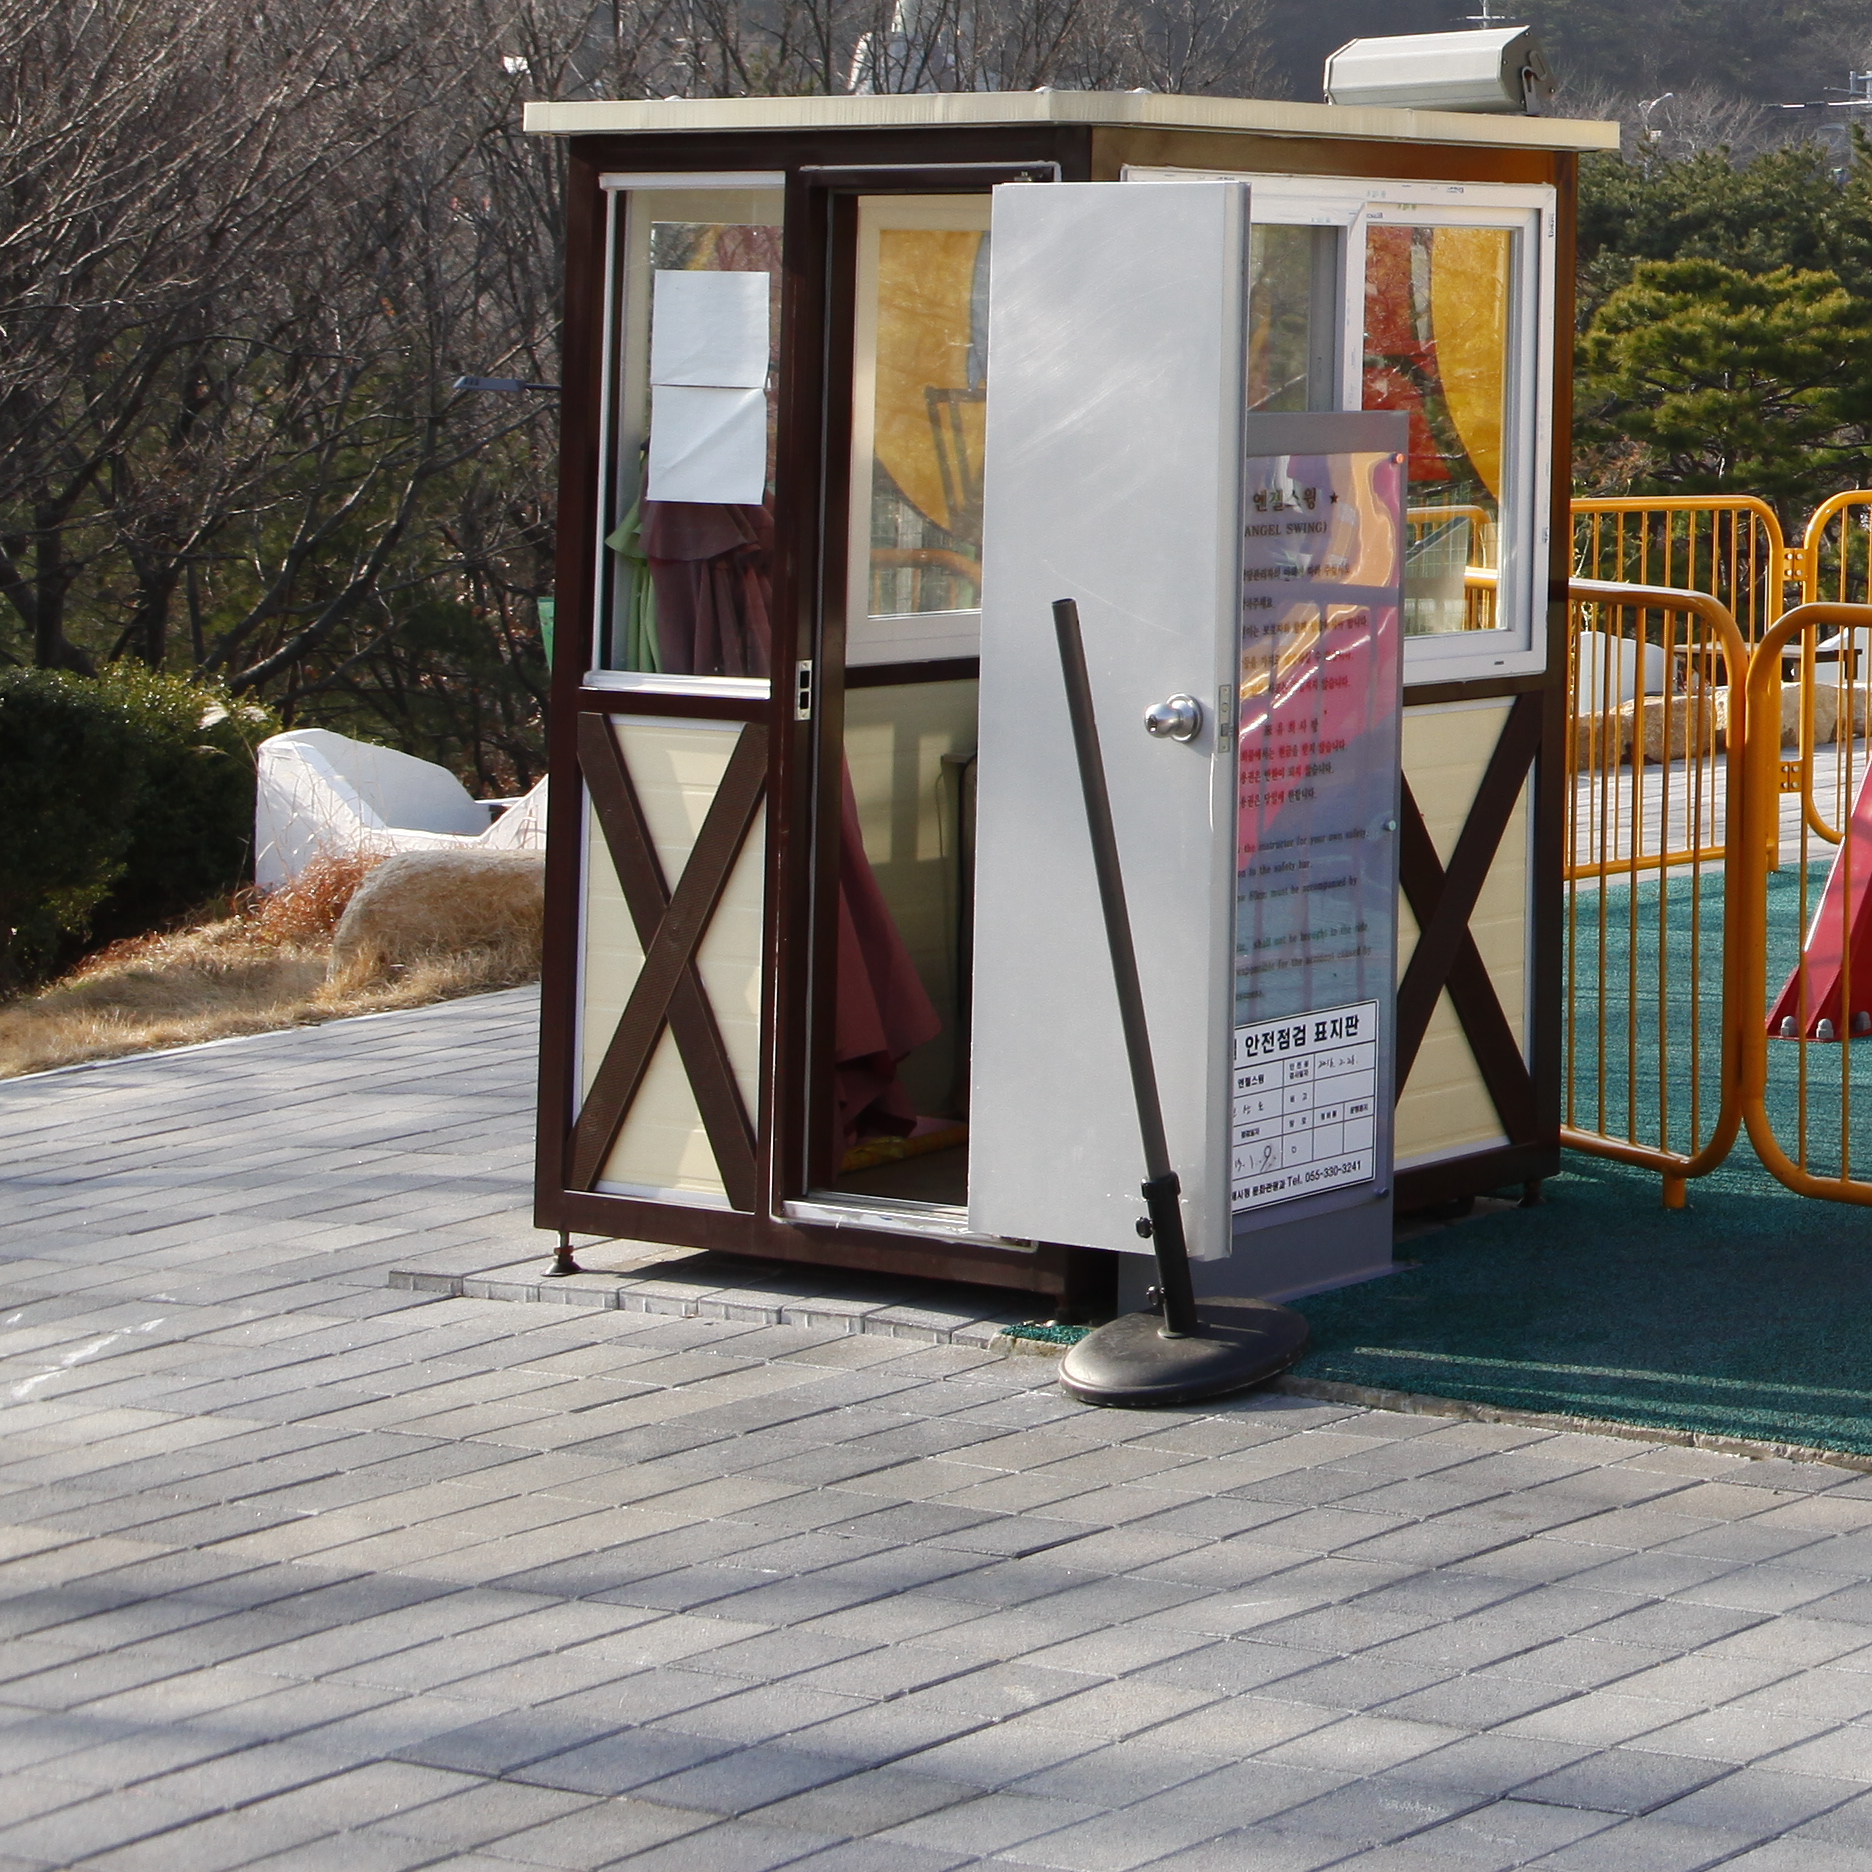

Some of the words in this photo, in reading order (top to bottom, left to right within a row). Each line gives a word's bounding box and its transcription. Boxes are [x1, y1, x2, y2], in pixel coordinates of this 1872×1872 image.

[1286, 522, 1327, 535] SWING)
[1245, 1024, 1306, 1058] 안전점검
[1314, 1014, 1360, 1042] 표지판
[1287, 1175, 1303, 1187] Tel.
[1305, 1160, 1361, 1183] 055-330-3241
